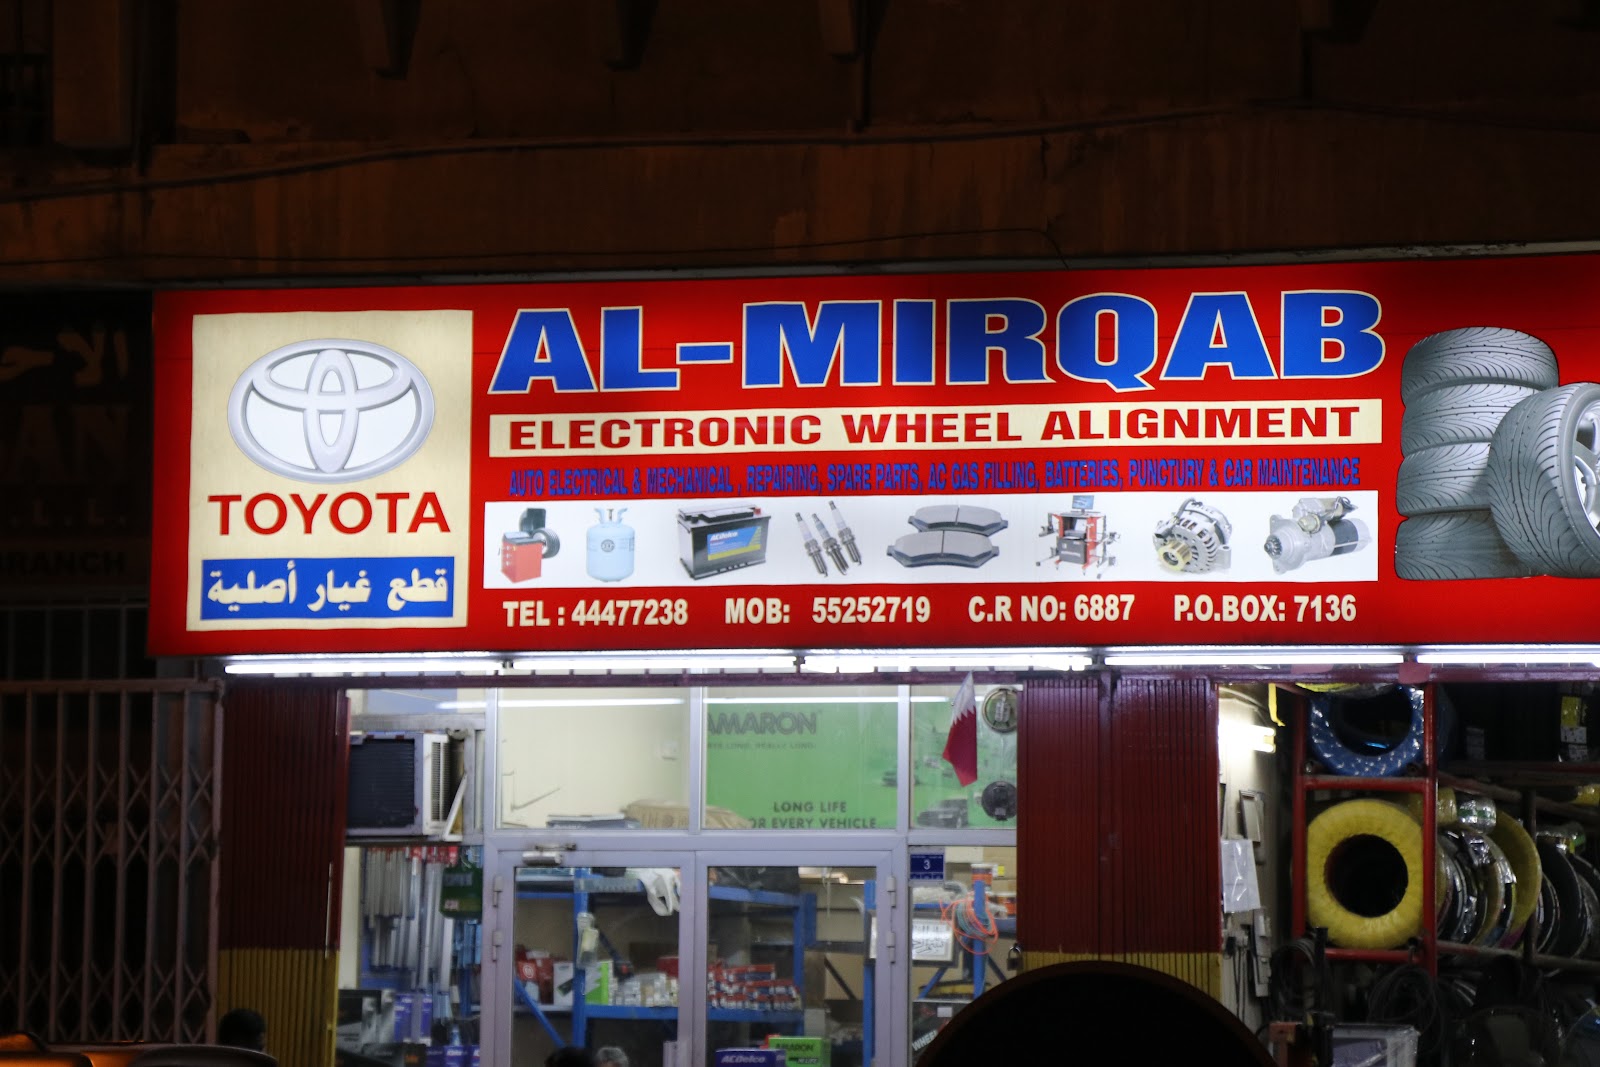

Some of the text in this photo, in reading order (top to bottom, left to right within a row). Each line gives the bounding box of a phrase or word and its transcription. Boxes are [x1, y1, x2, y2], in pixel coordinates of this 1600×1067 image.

[487, 290, 1386, 394] AL-MIRQAB
[0, 404, 131, 484] AN
[509, 406, 1360, 450] ELECTRONIC WHEEL ALIGNMENT
[509, 469, 544, 495] AUTO
[549, 467, 628, 495] ELECTRICAL
[632, 468, 641, 494] &
[647, 466, 733, 494] MECHANICAL
[747, 464, 822, 494] REPAIRING,
[827, 464, 871, 491] SPARE
[876, 463, 924, 494] PARTS,
[928, 463, 947, 490] AC
[951, 462, 979, 490] GAS
[984, 461, 1040, 492] FILLING,
[1045, 460, 1124, 491] BATTERIES,
[1129, 459, 1204, 487] PUNCTURY
[1208, 460, 1219, 487] &
[1223, 459, 1253, 487] CAR
[1258, 457, 1361, 486] MAINTENANCE
[208, 491, 450, 536] TOYOTA
[207, 560, 449, 612] قطع غيار أصلية
[502, 600, 551, 627] TEL
[571, 598, 689, 627] 44477238
[725, 597, 790, 625] MOB:
[812, 596, 931, 623] 55252719
[968, 595, 1013, 623] C.R
[1020, 594, 1067, 622] NO:
[1073, 593, 1136, 621] 6887
[1173, 594, 1286, 623] P.O.BOX:
[1294, 593, 1357, 622] 7136
[751, 816, 877, 829] OR EVERY VEHICLE
[773, 801, 847, 813] LONG LIFE
[923, 858, 931, 871] 3
[720, 1054, 767, 1064] ACDelco
